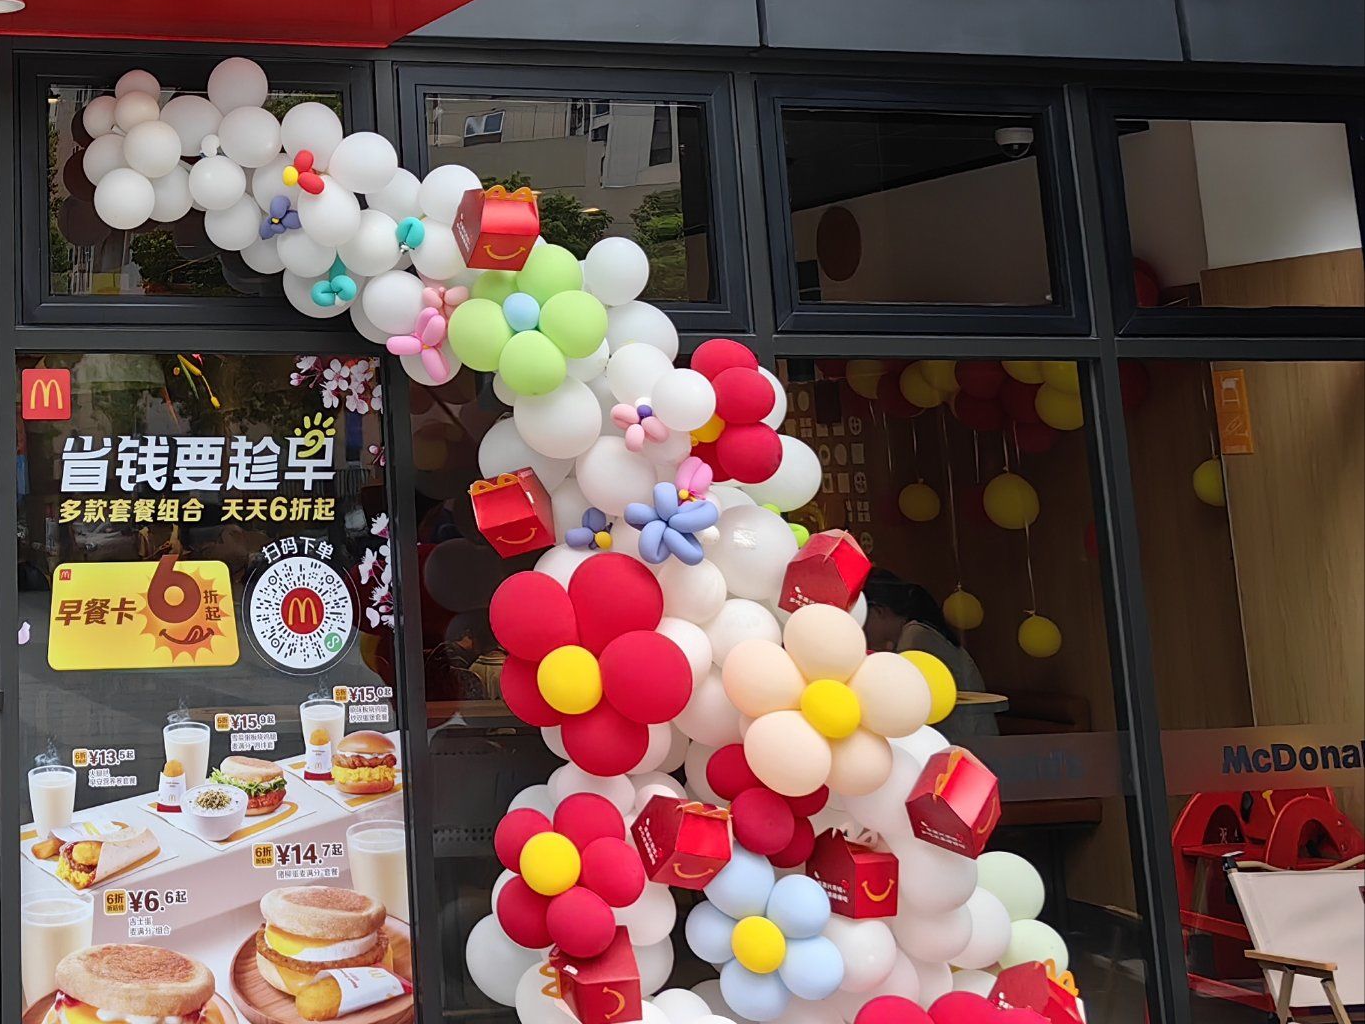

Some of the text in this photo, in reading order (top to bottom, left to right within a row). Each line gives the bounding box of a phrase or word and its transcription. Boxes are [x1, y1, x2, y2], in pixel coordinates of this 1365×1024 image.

[61, 433, 336, 493] 省钱要趁早
[59, 497, 336, 524] 多款套餐组合 天天6折起
[261, 536, 335, 564] 扫码下单
[54, 597, 137, 626] 早餐卡
[275, 843, 343, 865] ¥14.7起
[106, 890, 187, 912] 6折 ¥6.6起
